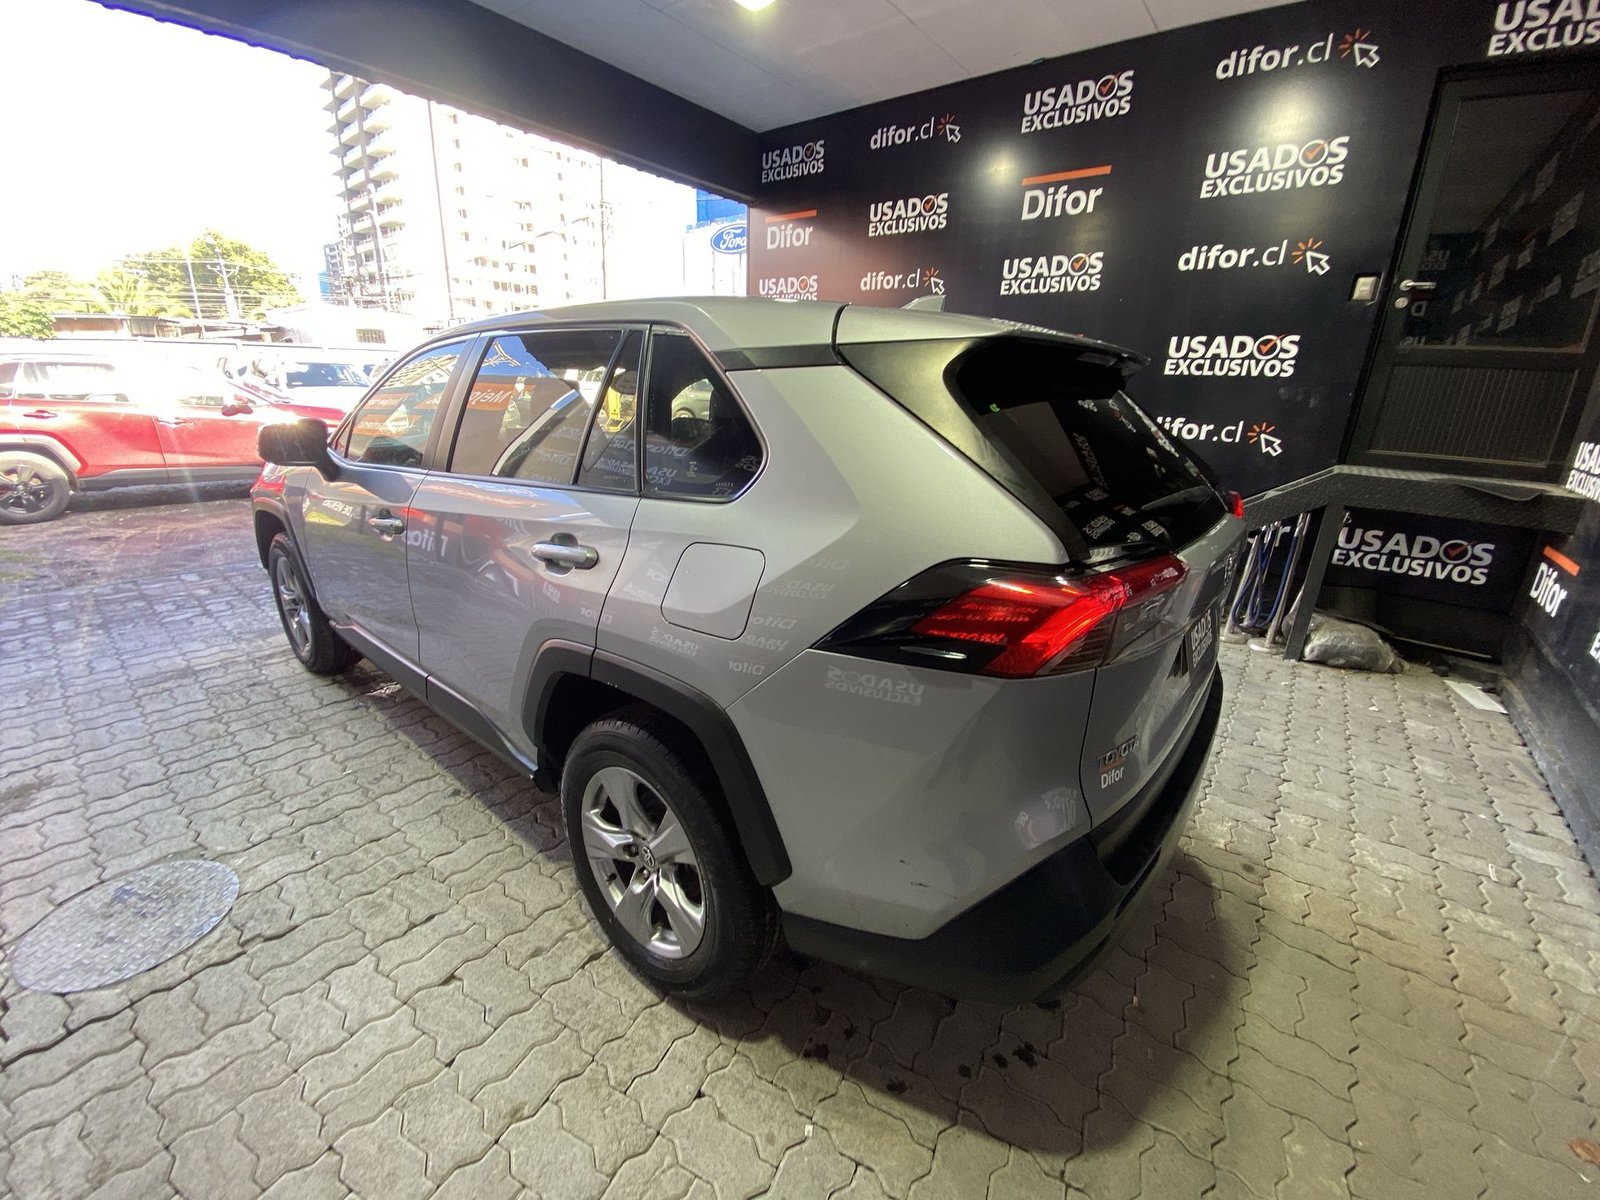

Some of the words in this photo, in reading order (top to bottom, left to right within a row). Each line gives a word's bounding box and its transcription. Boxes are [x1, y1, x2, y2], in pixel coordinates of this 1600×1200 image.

[1215, 32, 1335, 80] difor.cl
[1024, 69, 1134, 116] USADOS
[1020, 96, 1132, 134] EXCLUSIVOS
[870, 116, 935, 150] difor.cl
[761, 139, 825, 169] USADOS
[1204, 135, 1350, 179] USADOS
[761, 158, 825, 183] EXCLUSIVOS
[1200, 163, 1346, 199] EXCLUSIVOS
[869, 192, 949, 223] USADOS
[1021, 185, 1103, 221] Difor
[766, 223, 813, 250] Difor
[867, 213, 948, 237] EXCLUSIVOS
[1002, 251, 1104, 280] USADOS
[1177, 239, 1288, 272] difor.cl
[759, 275, 818, 296] USADOS
[859, 267, 921, 292] difor.cl
[1000, 273, 1102, 296] EXCLUSIVOS
[1168, 333, 1301, 360] USADOS
[1163, 358, 1296, 378] EXCLUSIVOS
[1156, 417, 1244, 444] ifor.cl
[1337, 526, 1496, 567] USADOS
[1331, 548, 1489, 585] EXCLUSIVOS
[1529, 561, 1568, 618] Difor
[1101, 767, 1124, 789] Difor
